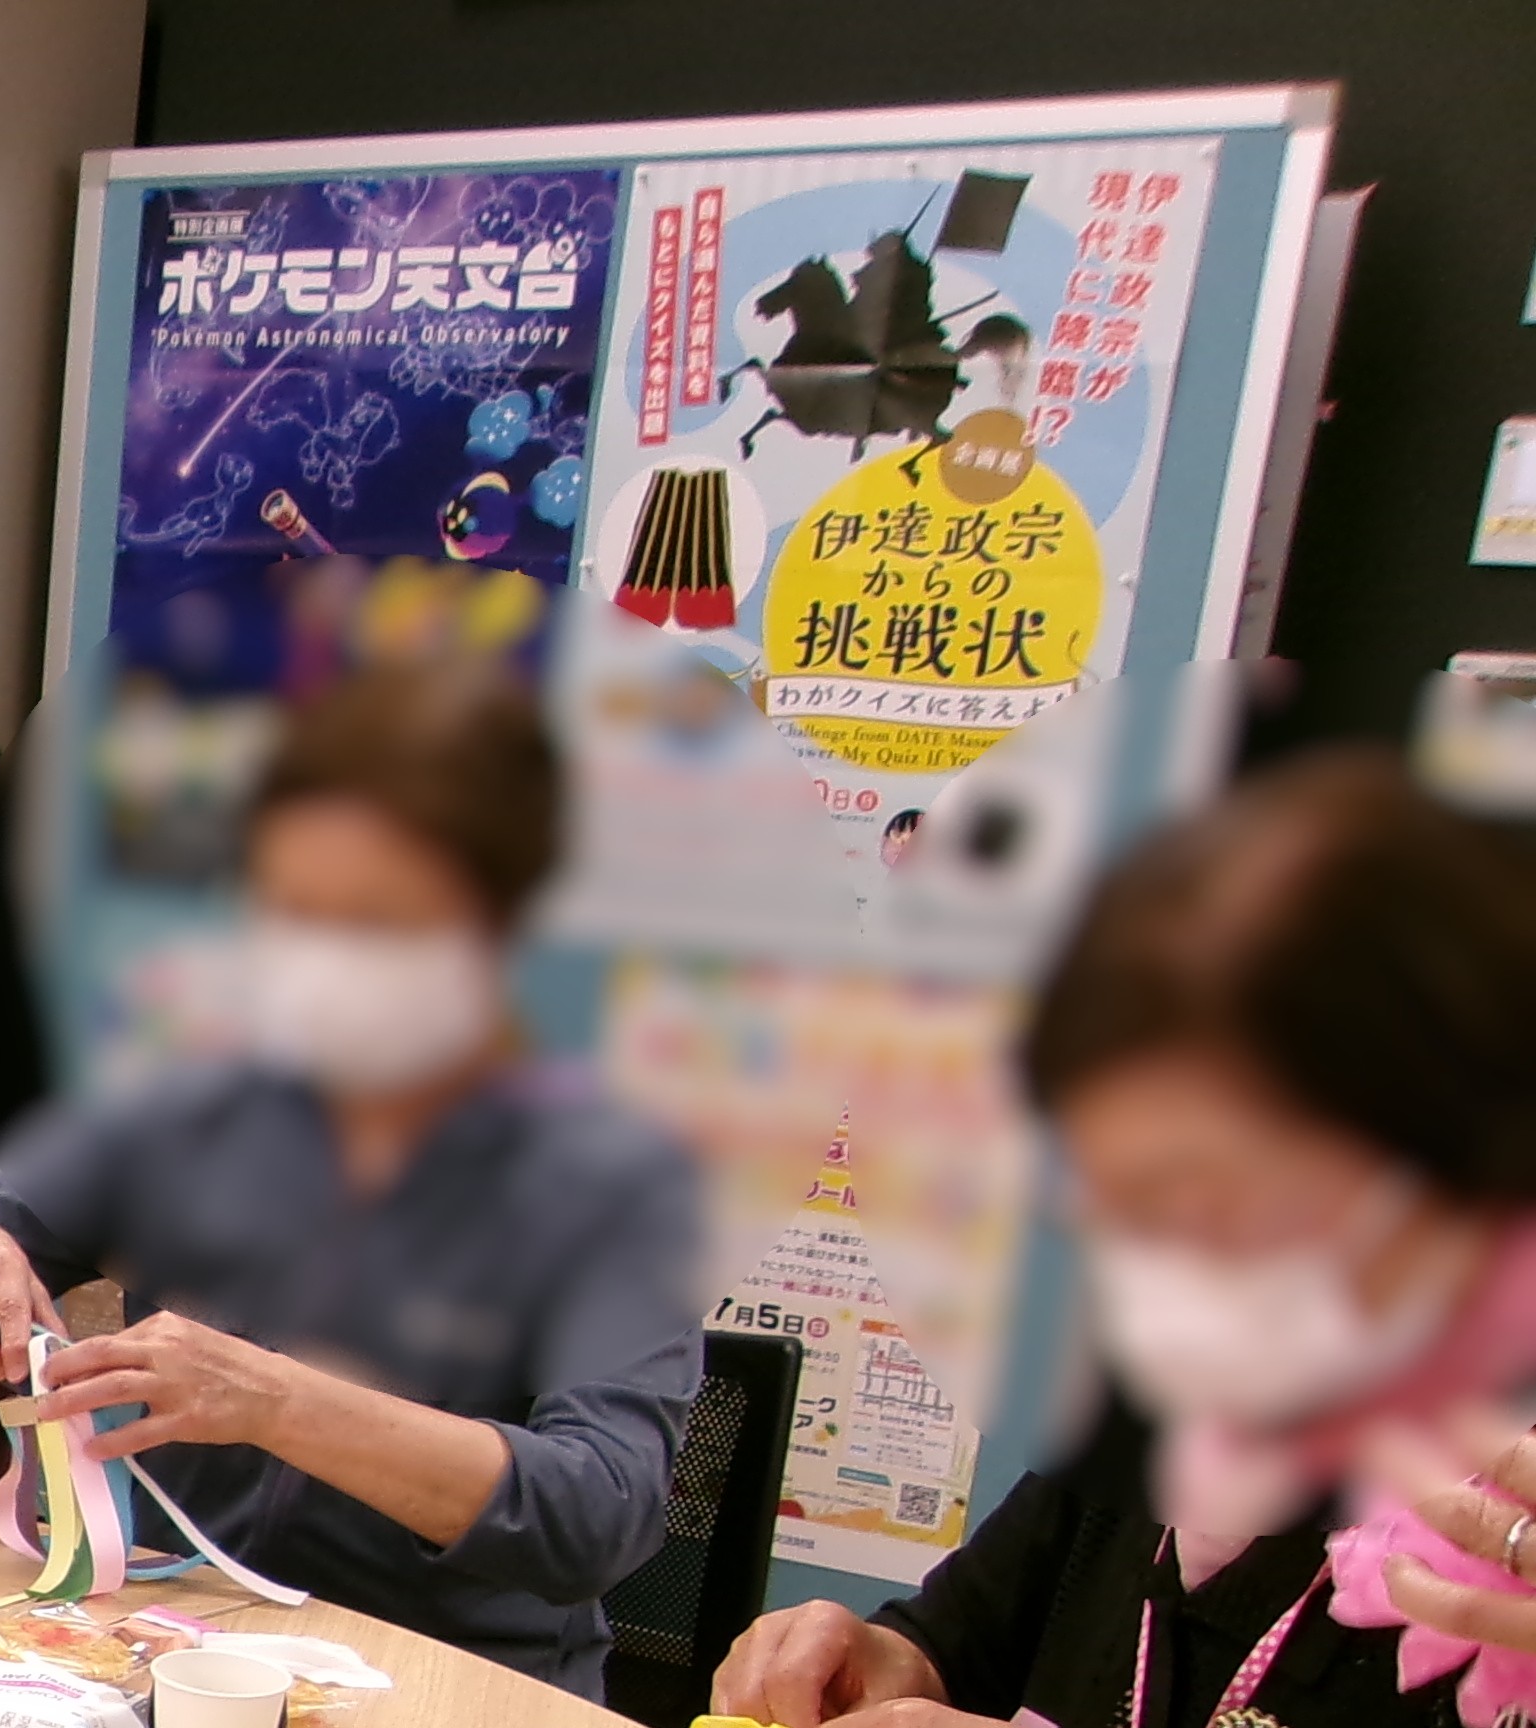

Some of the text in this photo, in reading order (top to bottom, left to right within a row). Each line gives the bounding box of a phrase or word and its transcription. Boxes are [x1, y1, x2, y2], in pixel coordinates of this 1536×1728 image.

[157, 238, 579, 316] ポケモン天文台
[1084, 170, 1182, 403] 伊達政宗が
[256, 324, 410, 349] Astronomical
[422, 321, 571, 350] Observatory
[812, 501, 1066, 564] 伊達政宗
[861, 558, 1014, 602] からの
[794, 599, 1047, 679] 挑戦状
[842, 745, 869, 766] My
[875, 747, 919, 768] Quiz
